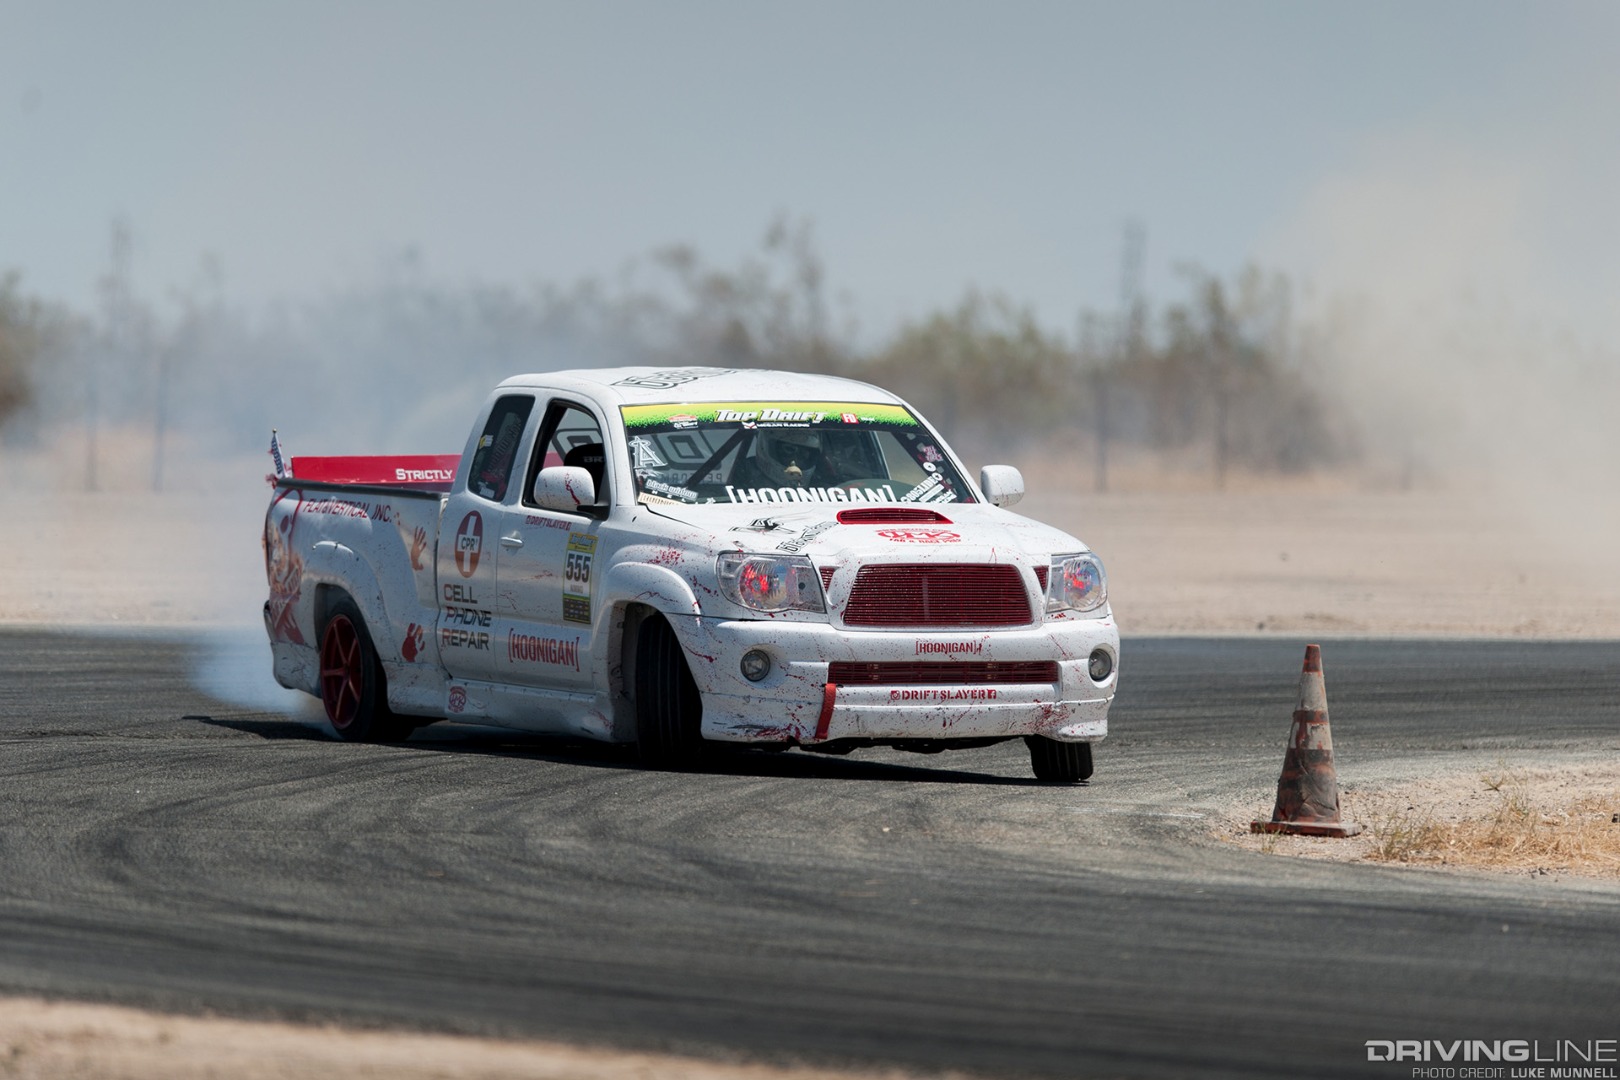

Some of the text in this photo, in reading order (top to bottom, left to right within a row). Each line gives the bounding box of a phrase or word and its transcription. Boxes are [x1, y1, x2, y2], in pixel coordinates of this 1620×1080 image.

[395, 468, 453, 480] STRICTLY
[372, 503, 392, 523] INC.
[565, 553, 591, 583] 555
[443, 583, 477, 604] CELL
[444, 605, 492, 627] PHONE
[441, 628, 489, 650] REPAIR
